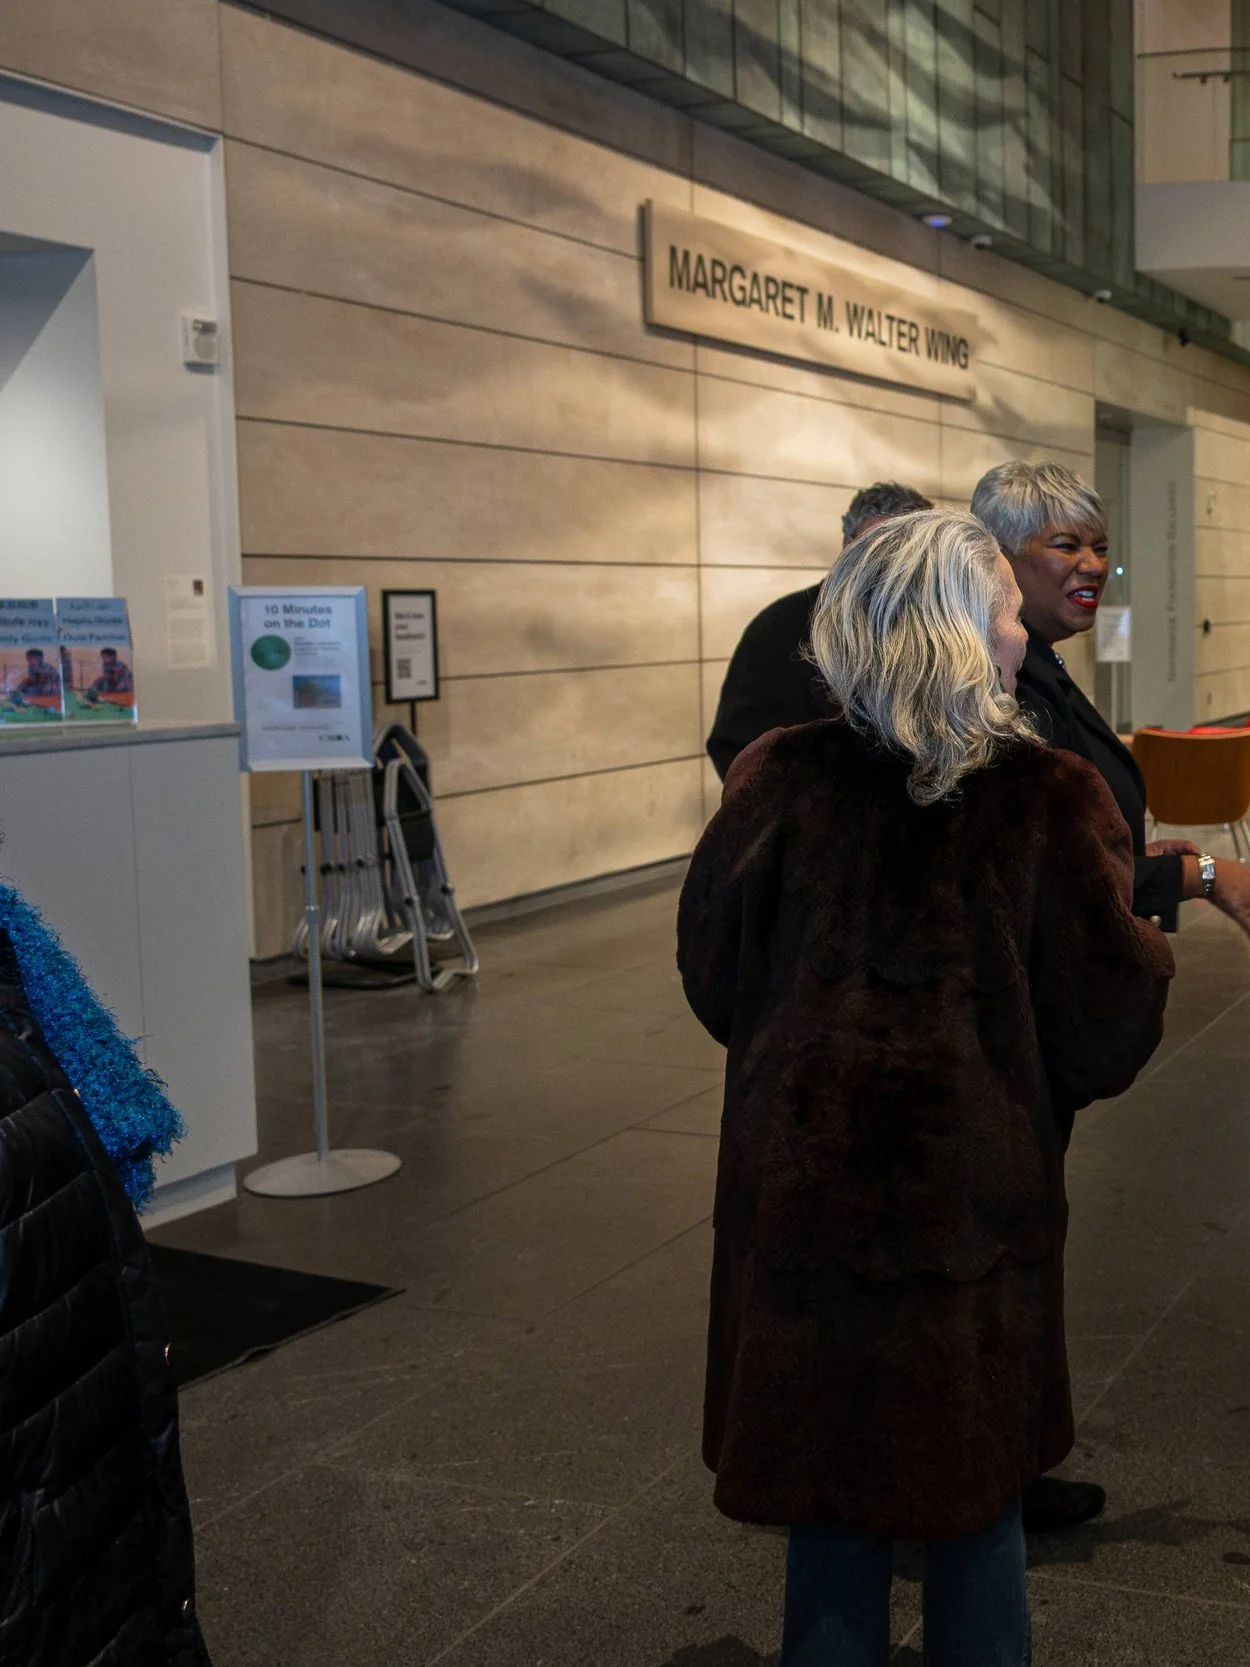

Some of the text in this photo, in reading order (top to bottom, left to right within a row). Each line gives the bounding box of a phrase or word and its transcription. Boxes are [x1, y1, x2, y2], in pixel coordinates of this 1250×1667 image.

[669, 245, 969, 370] MARGARET M. WALTER WING
[265, 604, 333, 615] 10 Minutes
[264, 618, 331, 629] on the Dot
